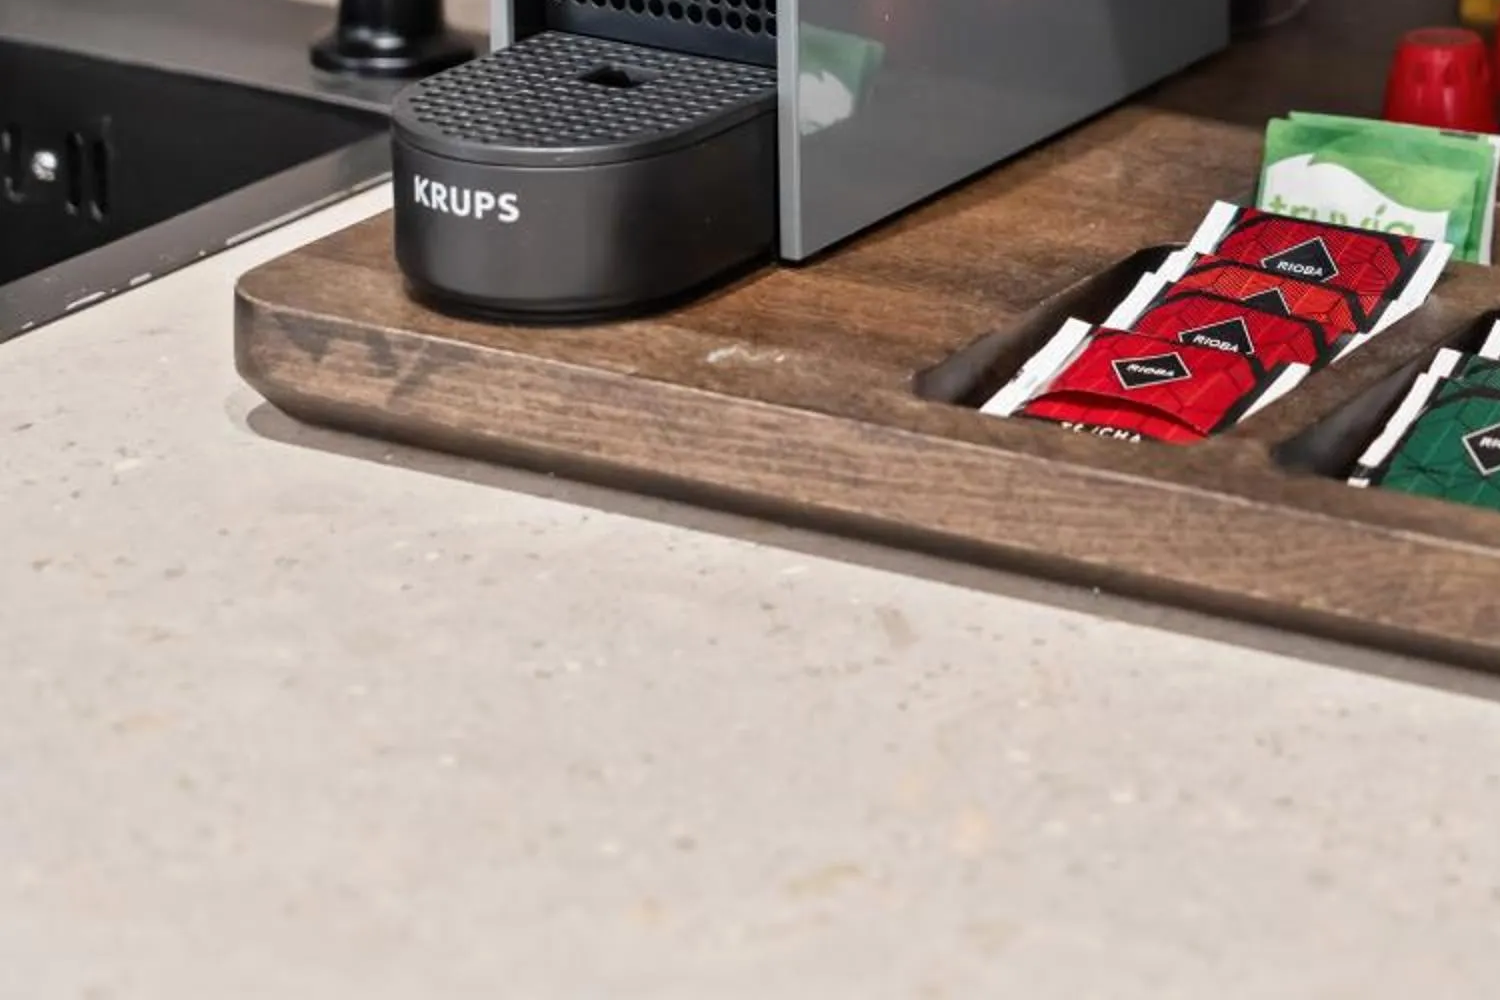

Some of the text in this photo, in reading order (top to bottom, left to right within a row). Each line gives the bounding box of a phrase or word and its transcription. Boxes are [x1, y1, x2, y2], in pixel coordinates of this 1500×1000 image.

[414, 174, 520, 223] KRUPS
[1276, 261, 1324, 277] RIOBA
[1193, 334, 1239, 353] RIOBA
[1126, 363, 1175, 378] RIOBA
